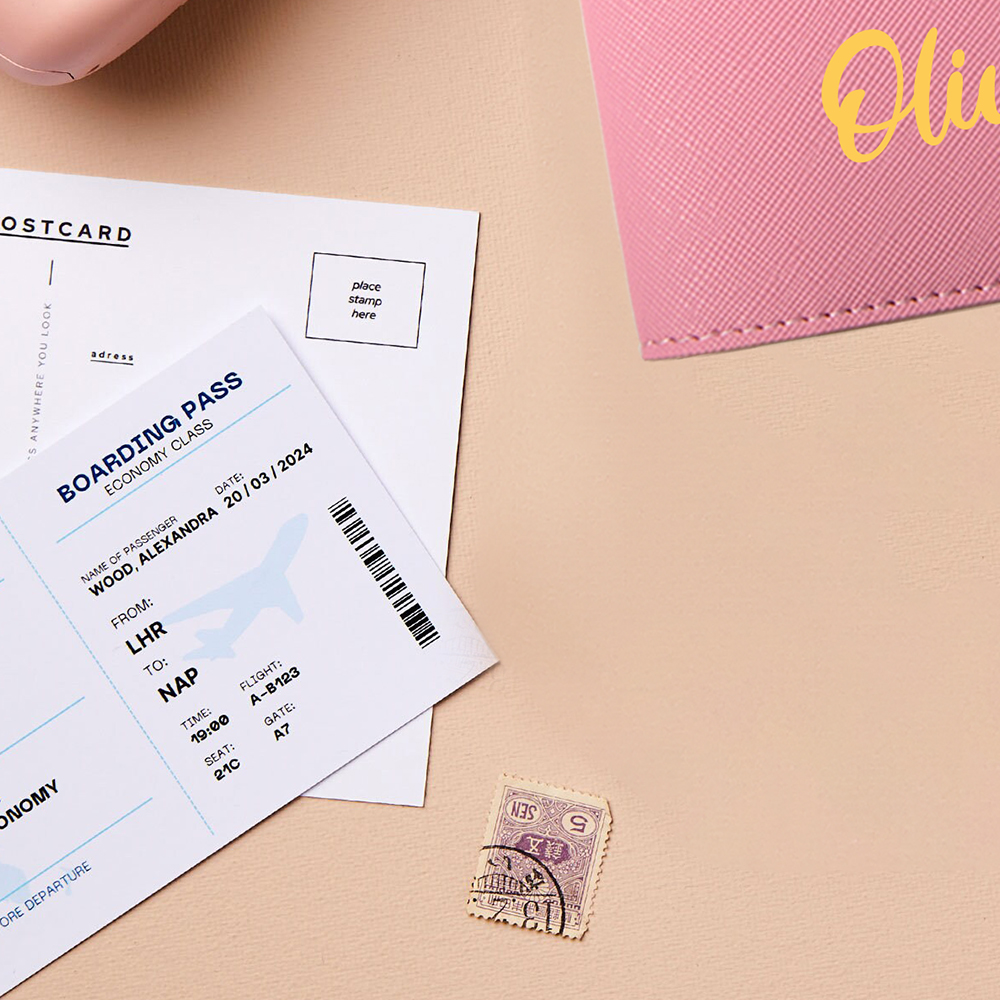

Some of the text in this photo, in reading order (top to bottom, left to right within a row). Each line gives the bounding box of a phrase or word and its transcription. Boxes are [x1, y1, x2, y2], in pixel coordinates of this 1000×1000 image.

[1, 216, 131, 241] OSTCARD
[351, 280, 382, 292] place
[348, 295, 382, 308] stamp
[351, 308, 376, 320] here
[40, 303, 52, 337] LOOK
[37, 342, 48, 368] YOU
[91, 351, 134, 361] adress
[29, 373, 45, 443] ANYWHERE
[56, 371, 243, 504] BOARDING PASS
[103, 418, 214, 497] ECONOMY CLASS
[214, 472, 245, 495] DATE:
[223, 490, 243, 509] 20
[250, 471, 271, 490] 03
[276, 442, 313, 473] 2024
[80, 515, 178, 584] NAME OF PASSENGER
[88, 506, 219, 597] WOOD, ALEXANDRA
[110, 598, 154, 630] FROM:
[125, 621, 168, 656] LHR
[142, 658, 169, 676] TO:
[239, 660, 283, 692] FLIGHT:
[157, 667, 199, 703] NAP
[250, 666, 301, 707] A-B123
[179, 708, 212, 731] TIME:
[263, 702, 296, 727] GATE:
[190, 714, 230, 744] 19:00
[273, 722, 290, 742] A7
[204, 743, 235, 767] SEAT:
[213, 758, 241, 782] 21C
[511, 800, 538, 821] SEN
[570, 815, 588, 833] 5
[24, 860, 92, 911] DEPARTURE
